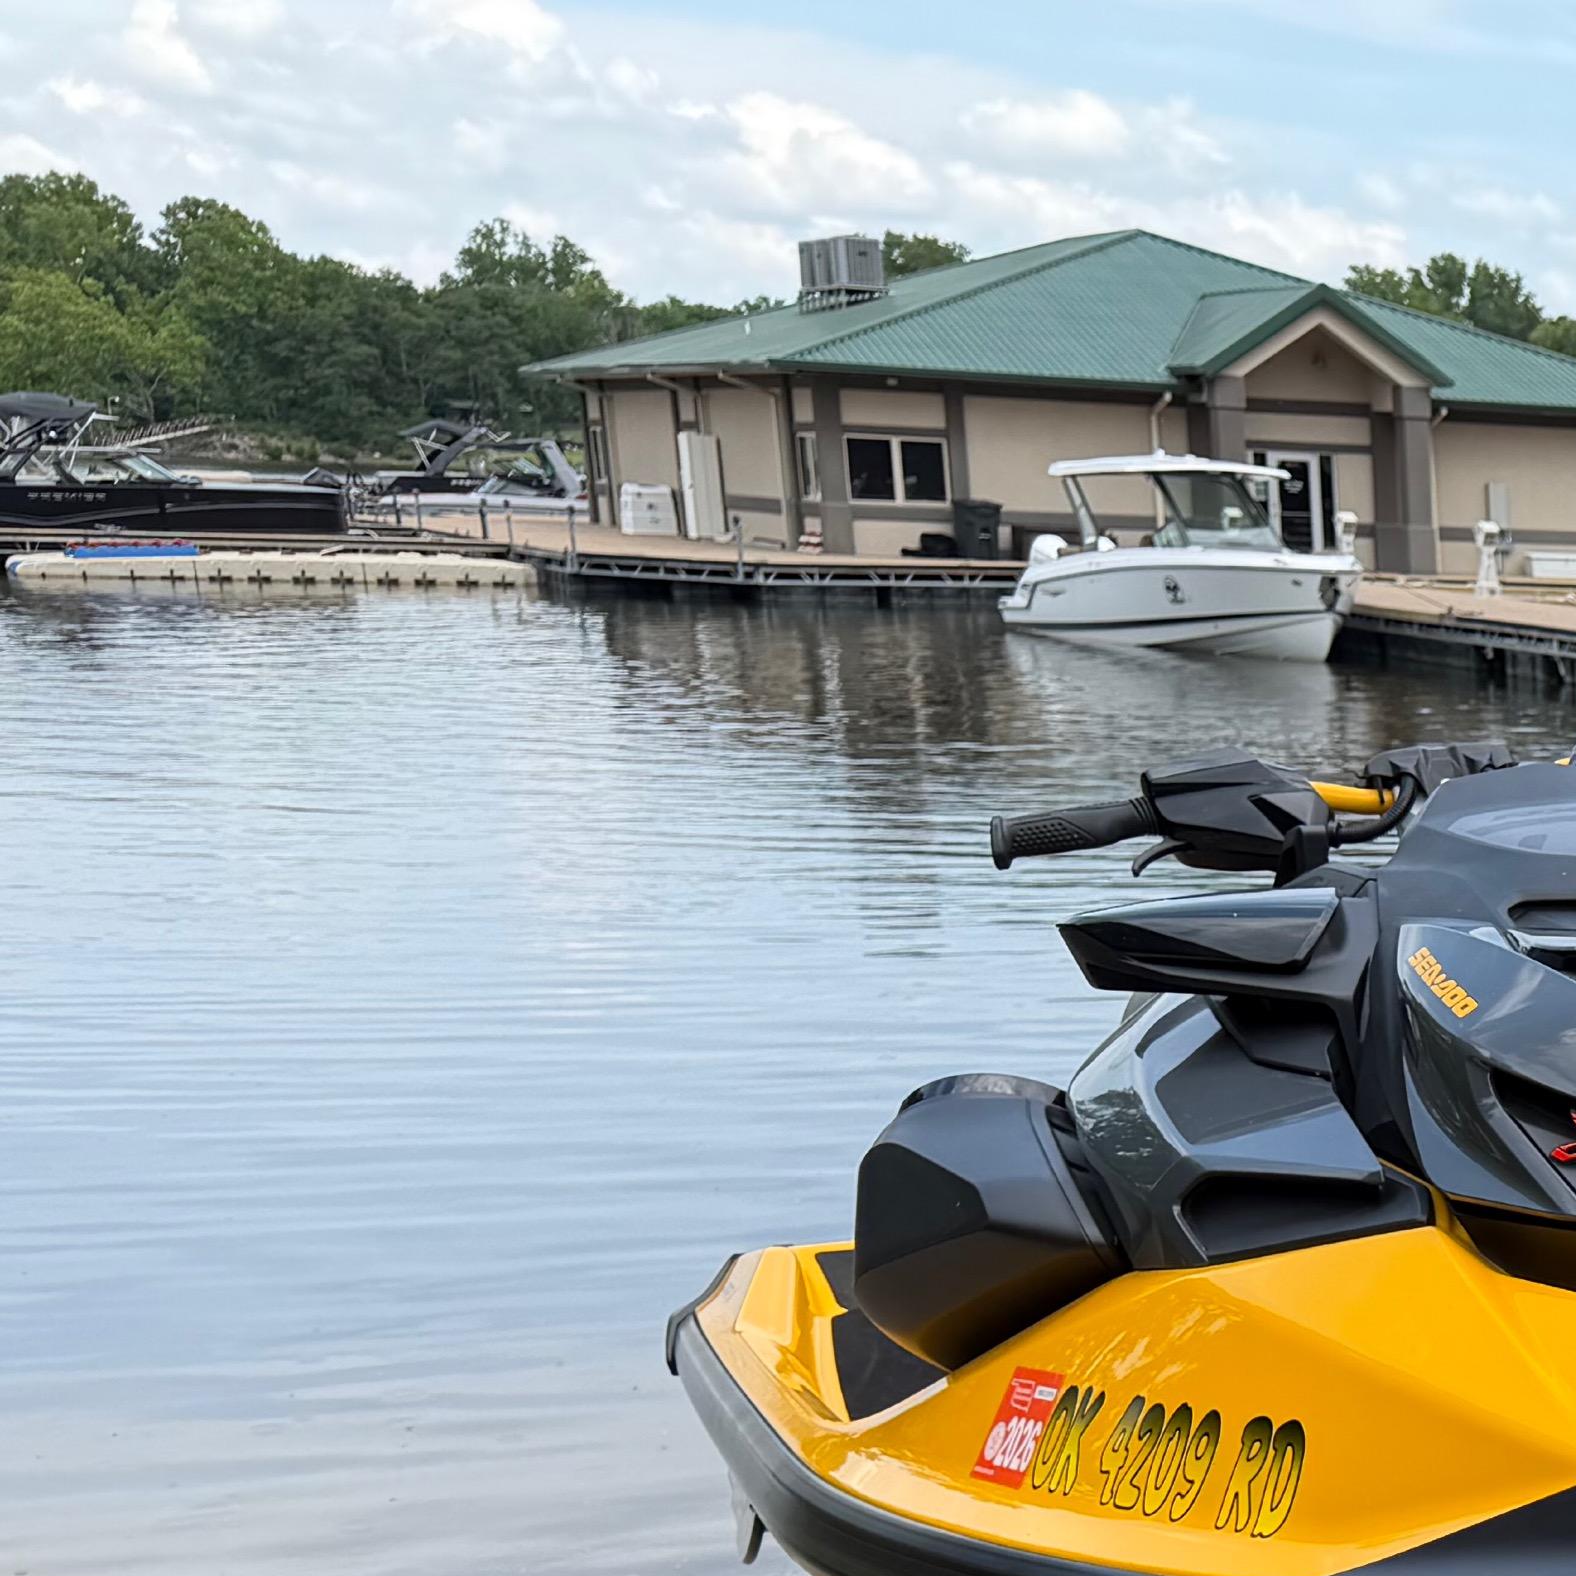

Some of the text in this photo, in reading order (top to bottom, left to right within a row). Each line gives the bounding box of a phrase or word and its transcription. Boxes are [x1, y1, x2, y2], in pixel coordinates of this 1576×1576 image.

[992, 1414, 1044, 1473] 2026
[1031, 1384, 1306, 1539] OK 4209 RD
